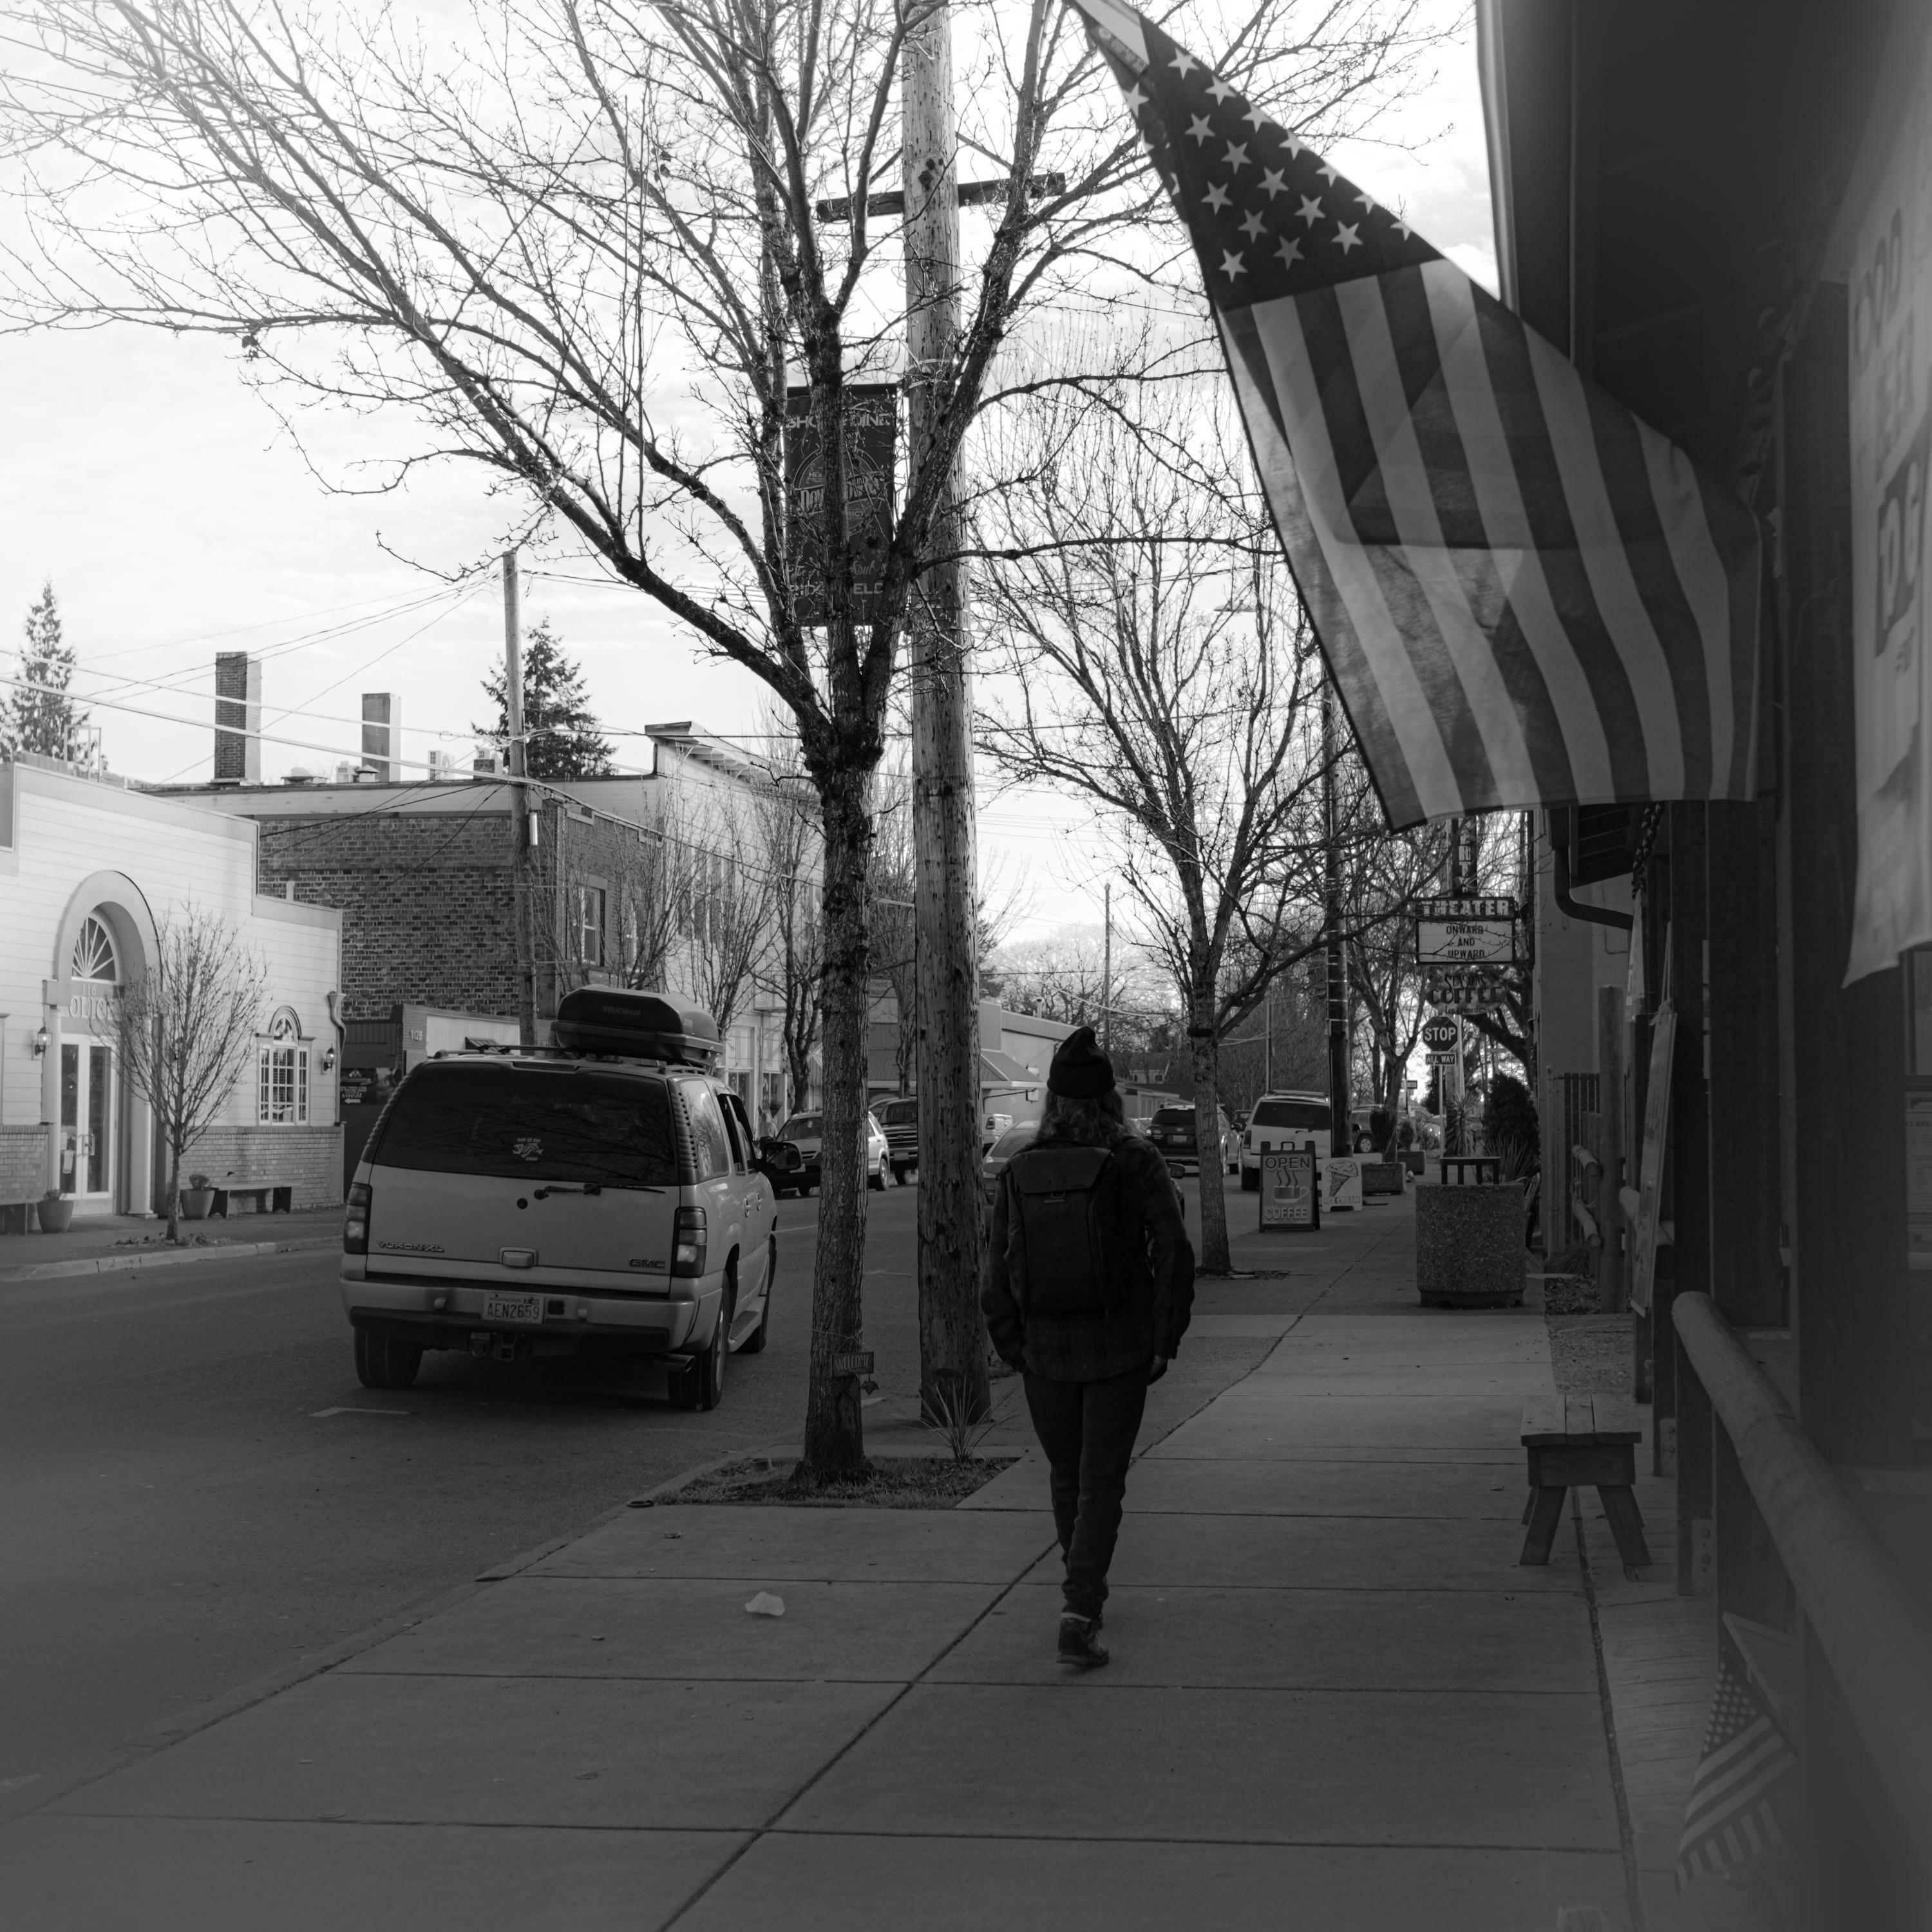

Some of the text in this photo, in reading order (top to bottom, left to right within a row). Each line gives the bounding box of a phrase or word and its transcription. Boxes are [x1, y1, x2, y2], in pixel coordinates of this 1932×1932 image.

[1420, 900, 1510, 916] THEATER
[1446, 925, 1483, 934] ONWARD
[1458, 938, 1475, 946] AND
[1448, 950, 1484, 958] UPWARD
[82, 983, 97, 996] 116
[1426, 986, 1502, 1004] COFFEE
[1425, 1027, 1456, 1041] STOP
[1265, 1157, 1311, 1170] OPEN
[1265, 1207, 1309, 1220] COFFEE
[629, 1257, 666, 1269] GMC
[488, 1303, 540, 1320] AEN2659
